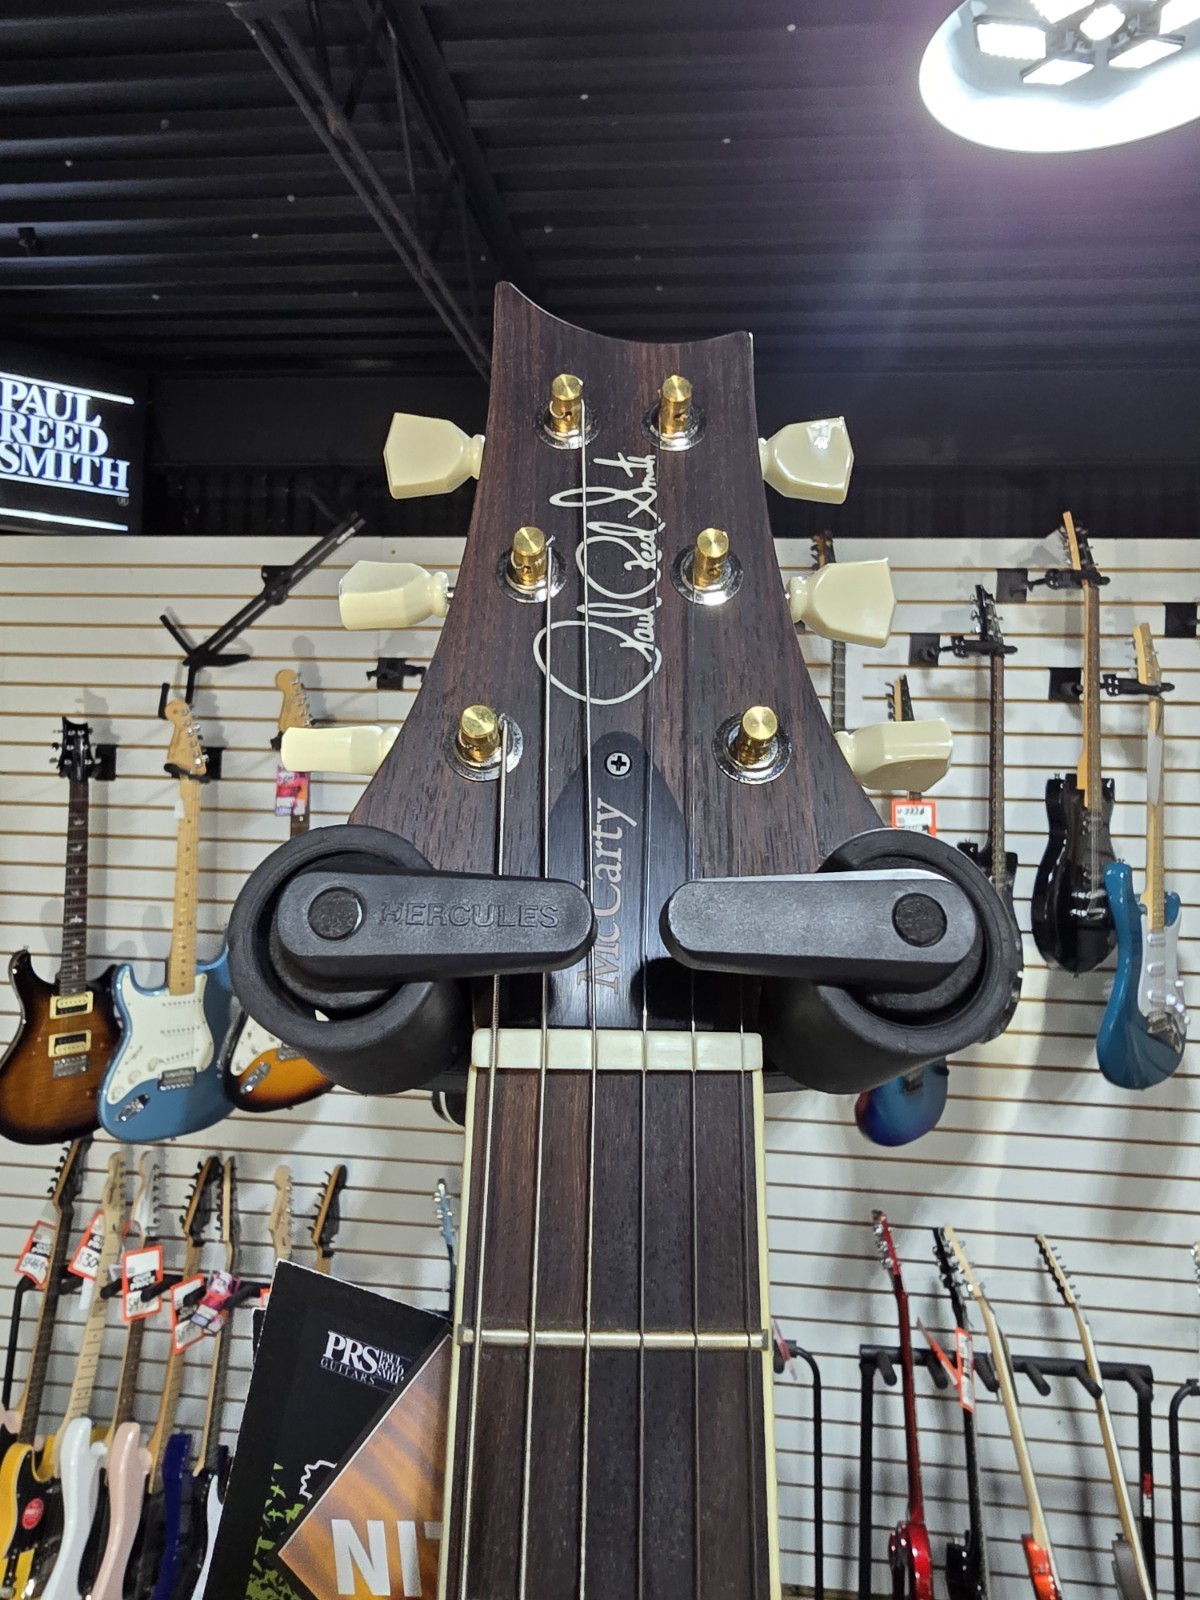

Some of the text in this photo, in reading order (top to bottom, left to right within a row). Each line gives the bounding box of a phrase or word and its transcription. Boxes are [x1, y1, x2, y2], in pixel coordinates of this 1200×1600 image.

[0, 378, 102, 427] PAUL
[0, 411, 109, 457] REED
[0, 441, 130, 491] SMITH
[380, 901, 559, 928] HERCULES
[320, 1358, 376, 1385] GUITARS
[323, 1331, 380, 1374] PRS
